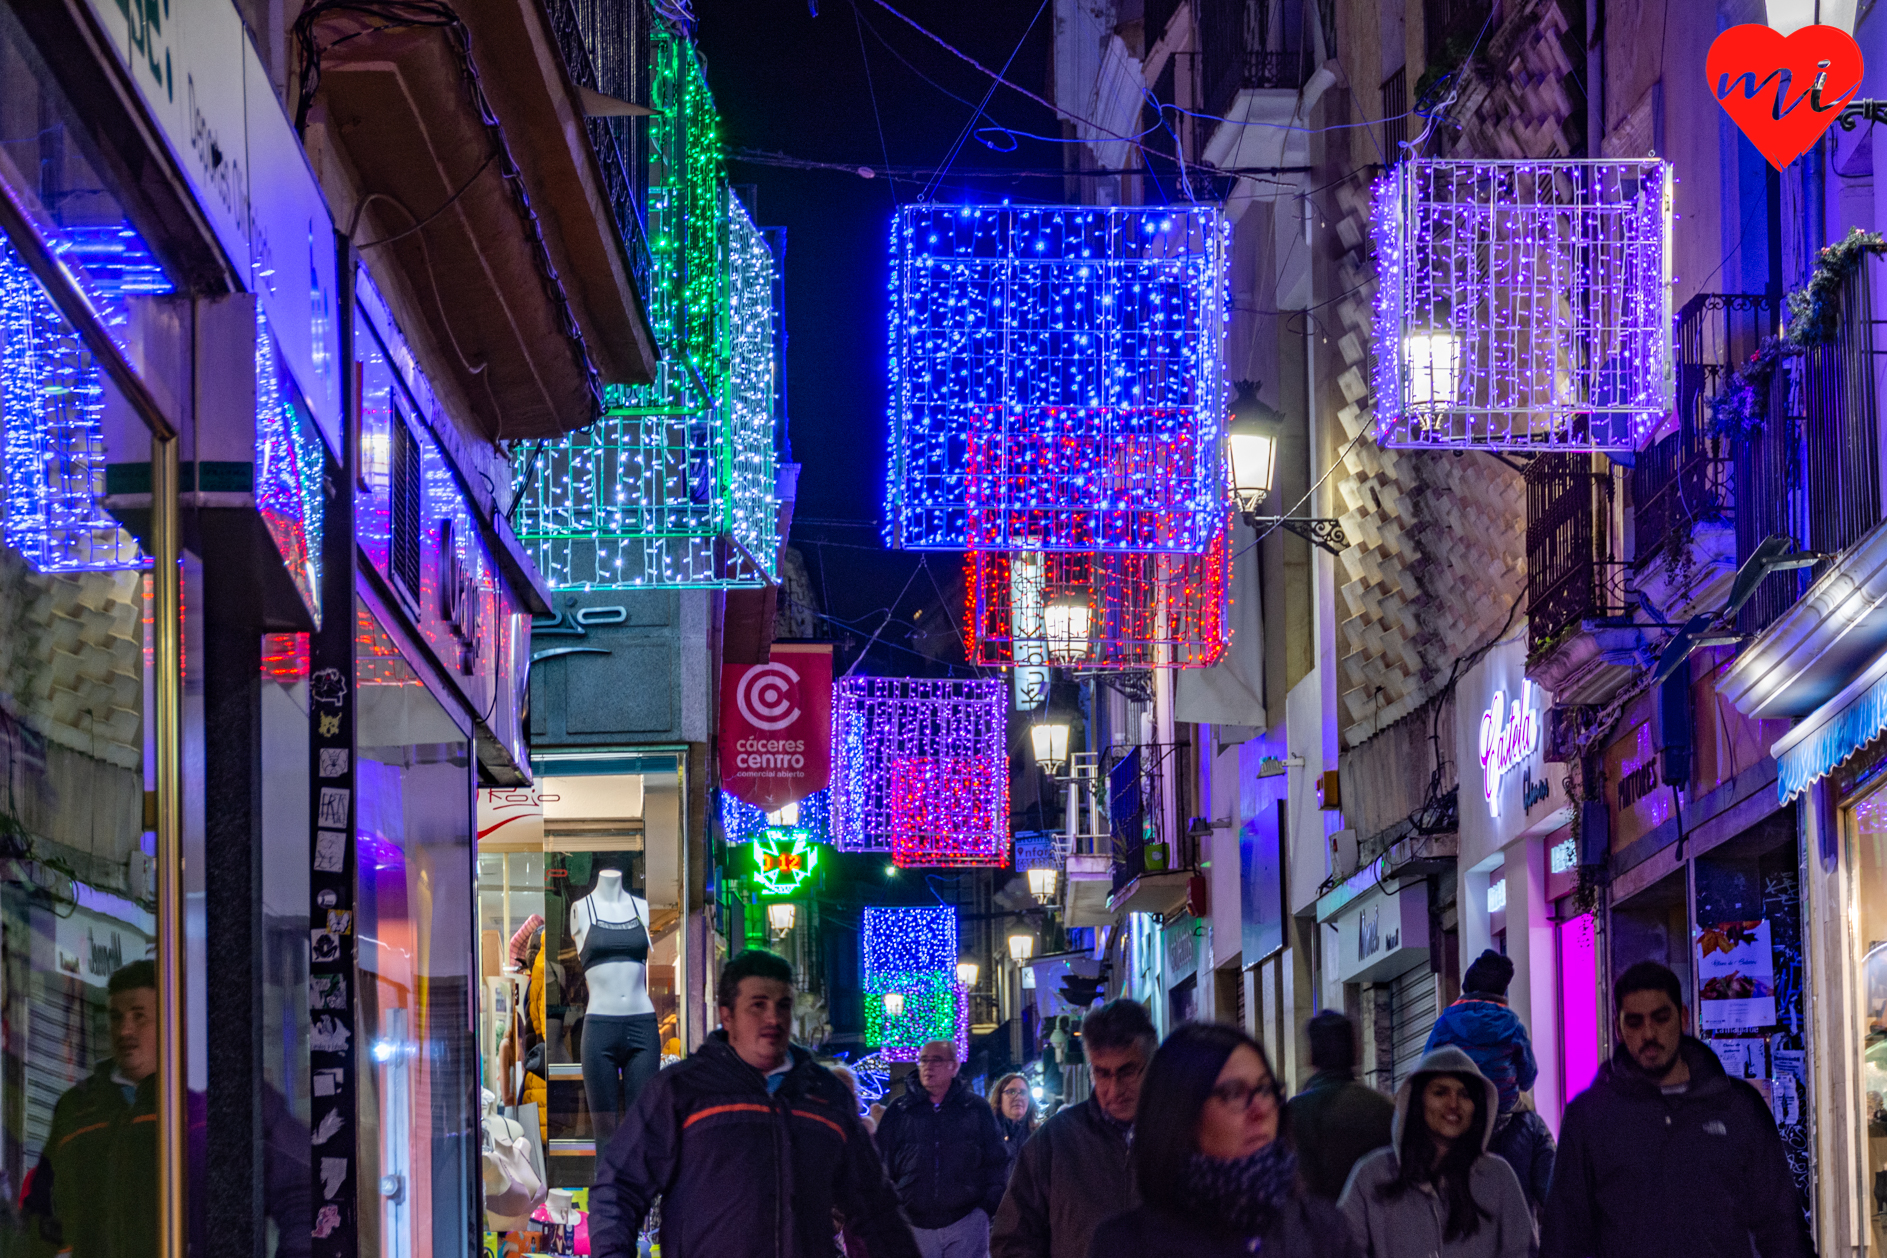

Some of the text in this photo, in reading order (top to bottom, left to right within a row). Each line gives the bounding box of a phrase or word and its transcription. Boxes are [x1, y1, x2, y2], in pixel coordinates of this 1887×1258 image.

[187, 72, 232, 215] Depotes
[736, 735, 805, 752] cáceres
[736, 753, 804, 769] centro
[1617, 756, 1658, 812] PINTORES
